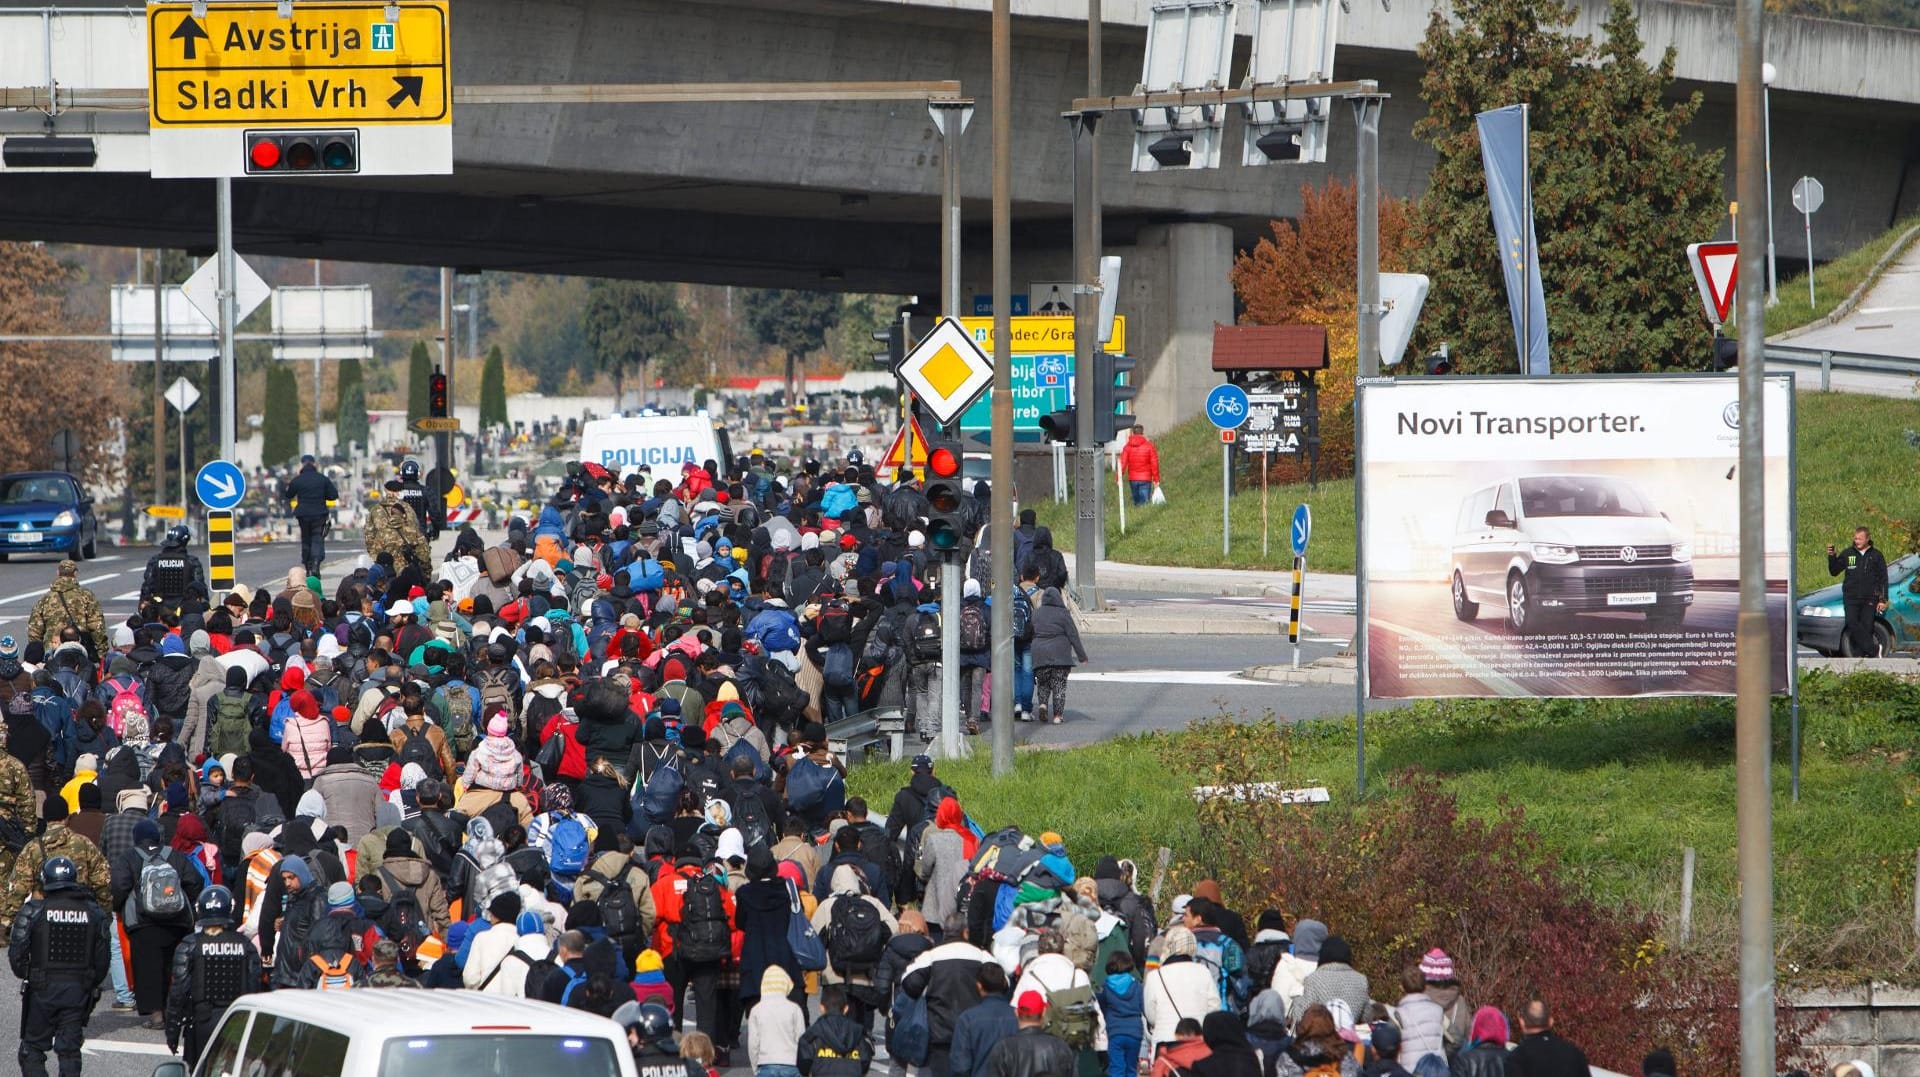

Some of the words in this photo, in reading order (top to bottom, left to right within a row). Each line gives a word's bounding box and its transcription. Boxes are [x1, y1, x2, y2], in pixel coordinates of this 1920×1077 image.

[223, 20, 361, 59] Avstrija
[177, 79, 289, 110] Sladki
[308, 79, 367, 109] Vrh
[1397, 410, 1462, 435] Novi
[1469, 410, 1647, 440] Transporter.
[601, 446, 697, 467] POLICIJA
[158, 559, 185, 568] POLICIJA
[46, 909, 88, 924] POLICIJA
[202, 943, 244, 956] POLICIJA
[641, 1064, 688, 1077] POLICIJA
